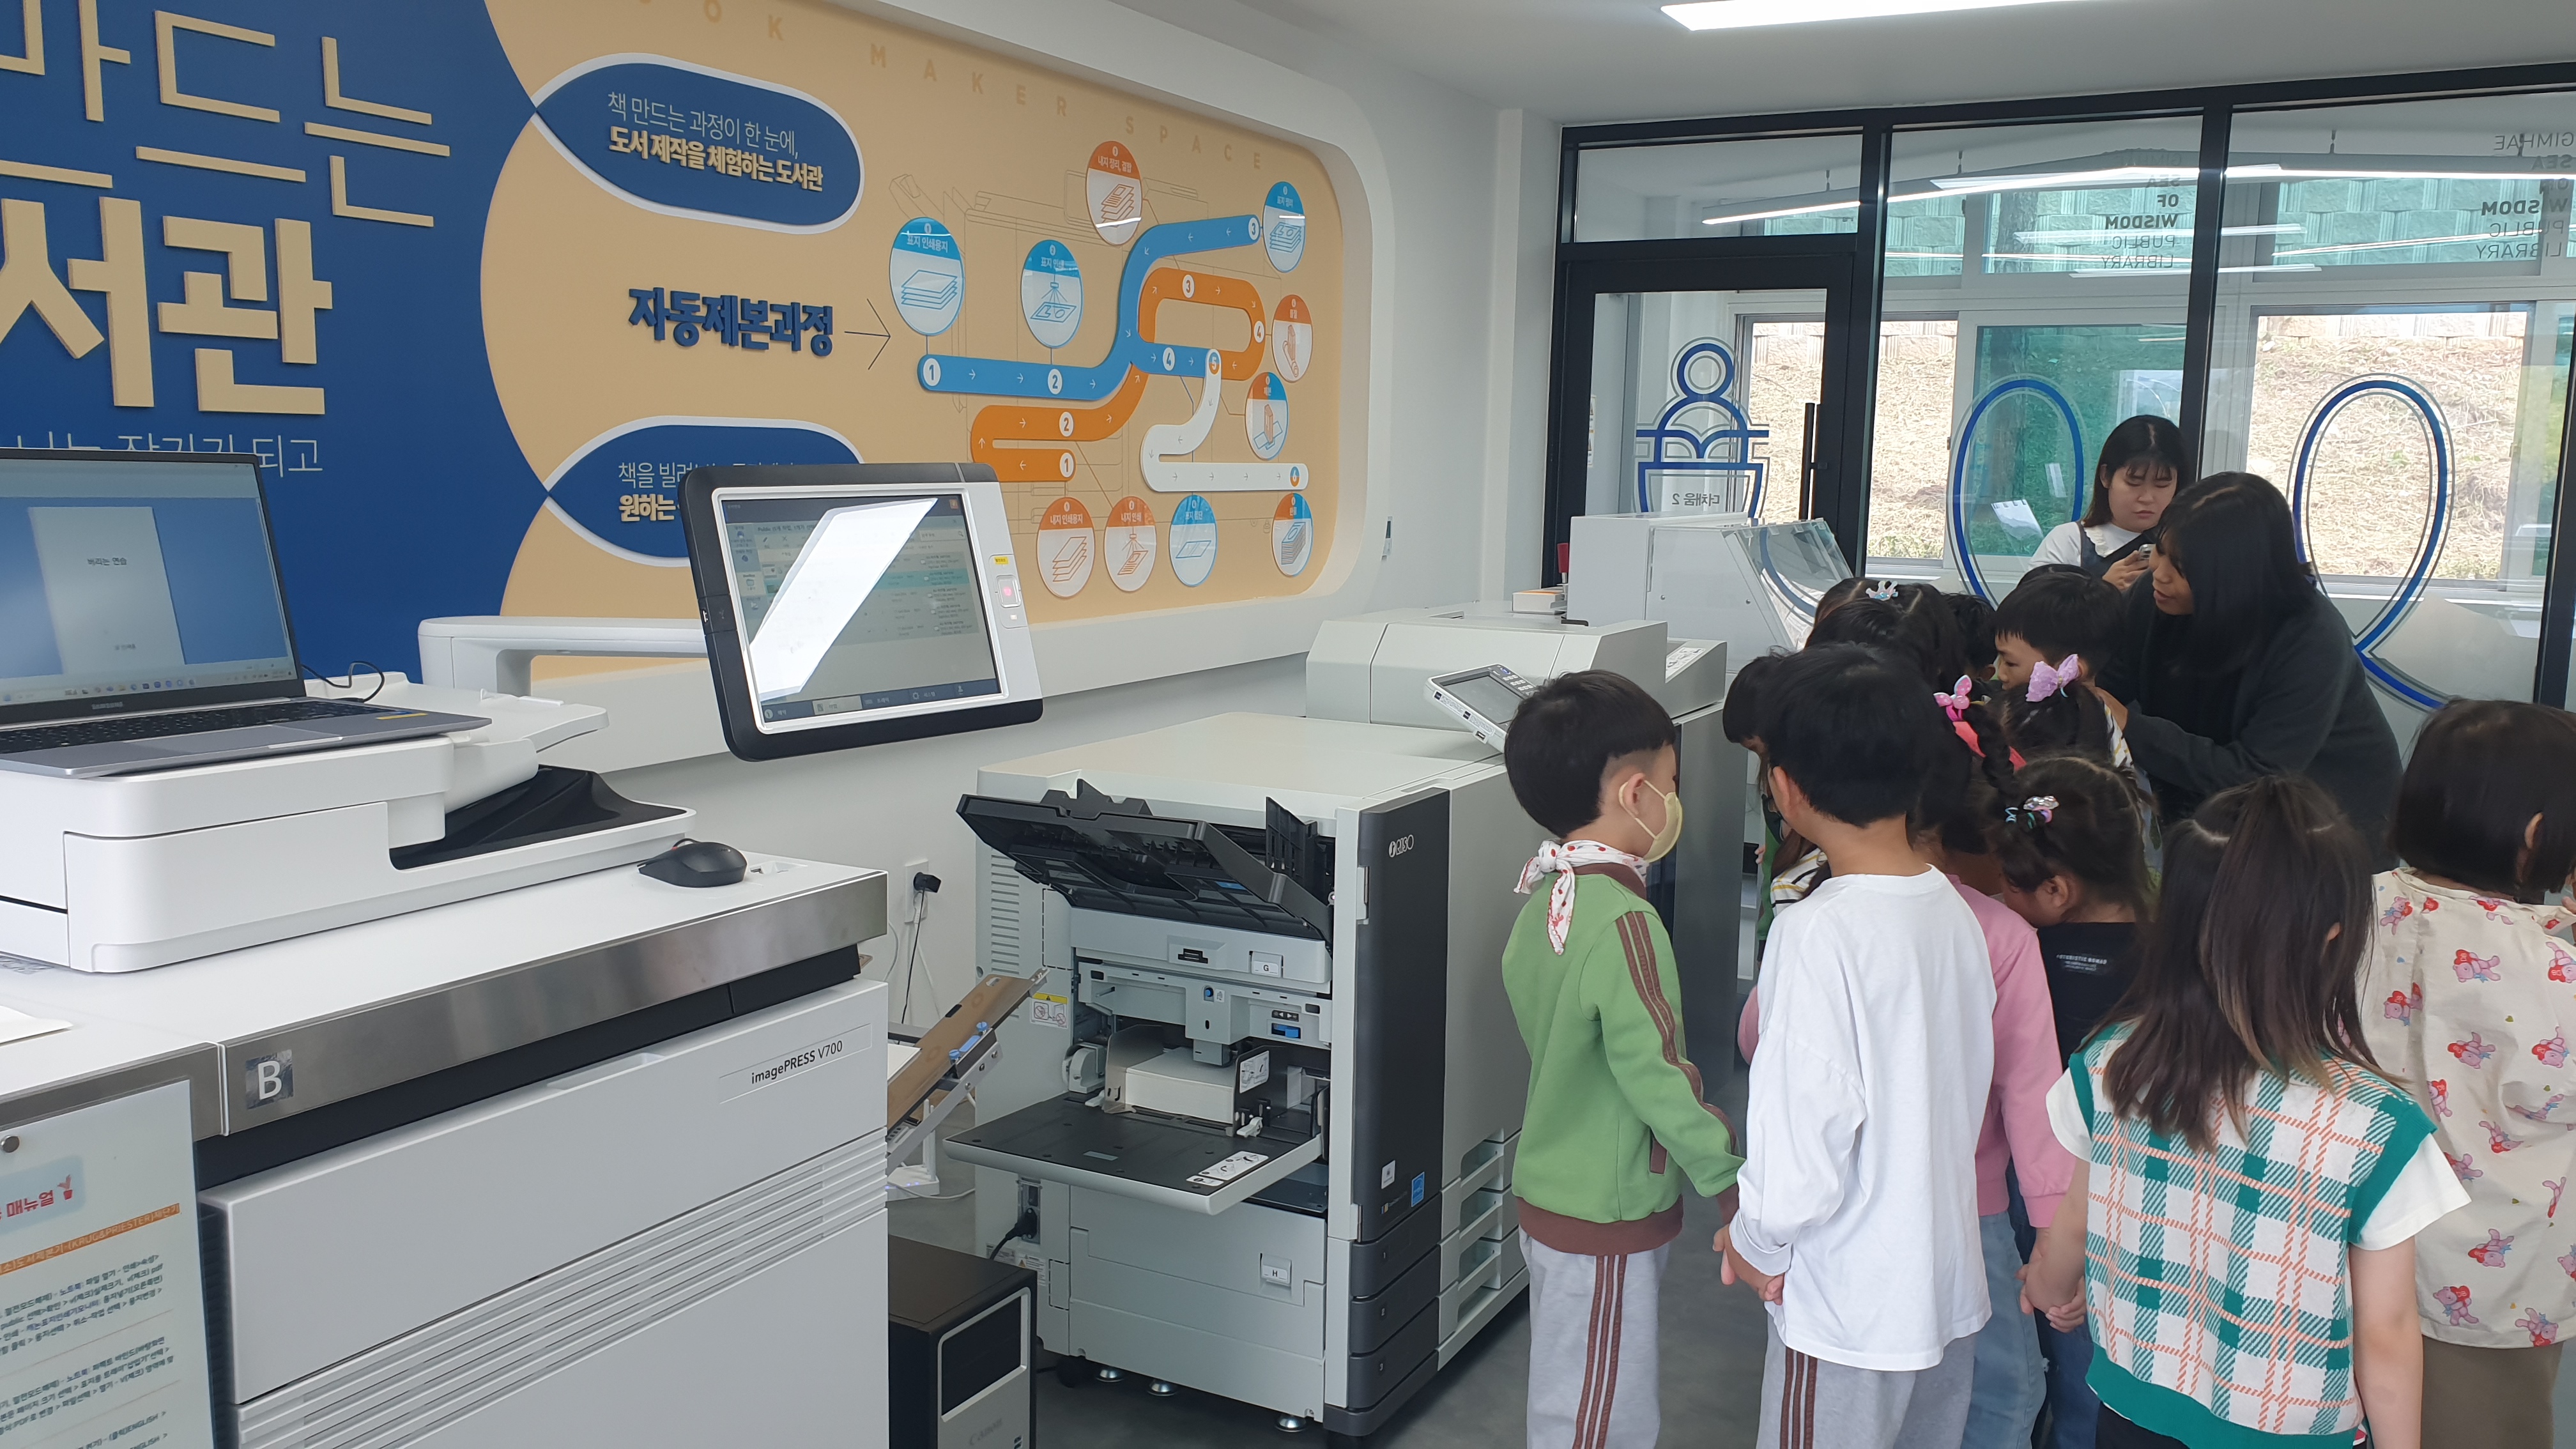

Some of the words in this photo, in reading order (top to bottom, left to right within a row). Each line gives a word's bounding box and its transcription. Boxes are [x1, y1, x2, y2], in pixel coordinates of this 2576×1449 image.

[870, 43, 1068, 118] MAKER
[1125, 115, 1262, 171] SPACE
[608, 91, 627, 121] 책
[631, 98, 686, 133] 만드는
[689, 111, 740, 144] 과정이
[744, 121, 761, 148] 한
[763, 126, 799, 160] 눈에,
[608, 126, 649, 160] 도서
[650, 134, 706, 170] 제작을
[707, 145, 775, 183] 체험하는
[776, 159, 824, 192] 도서관
[907, 234, 921, 248] 표지
[922, 236, 949, 254] 인쇄용지
[628, 287, 834, 357] 자동제본과정
[252, 434, 323, 478] 되고
[618, 461, 656, 489] 책을
[618, 493, 676, 523] 원하는
[1050, 514, 1061, 525] 내지
[1062, 513, 1084, 525] 인쇄용지
[87, 557, 110, 566] 버리는
[112, 556, 128, 566] 연습
[1396, 834, 1414, 855] RISO
[1262, 963, 1269, 972] G
[751, 1050, 815, 1084] imagePRESS
[818, 1040, 843, 1059] V700
[258, 1061, 282, 1100] B
[6, 1190, 54, 1218] 매뉴얼
[1272, 1269, 1278, 1278] H
